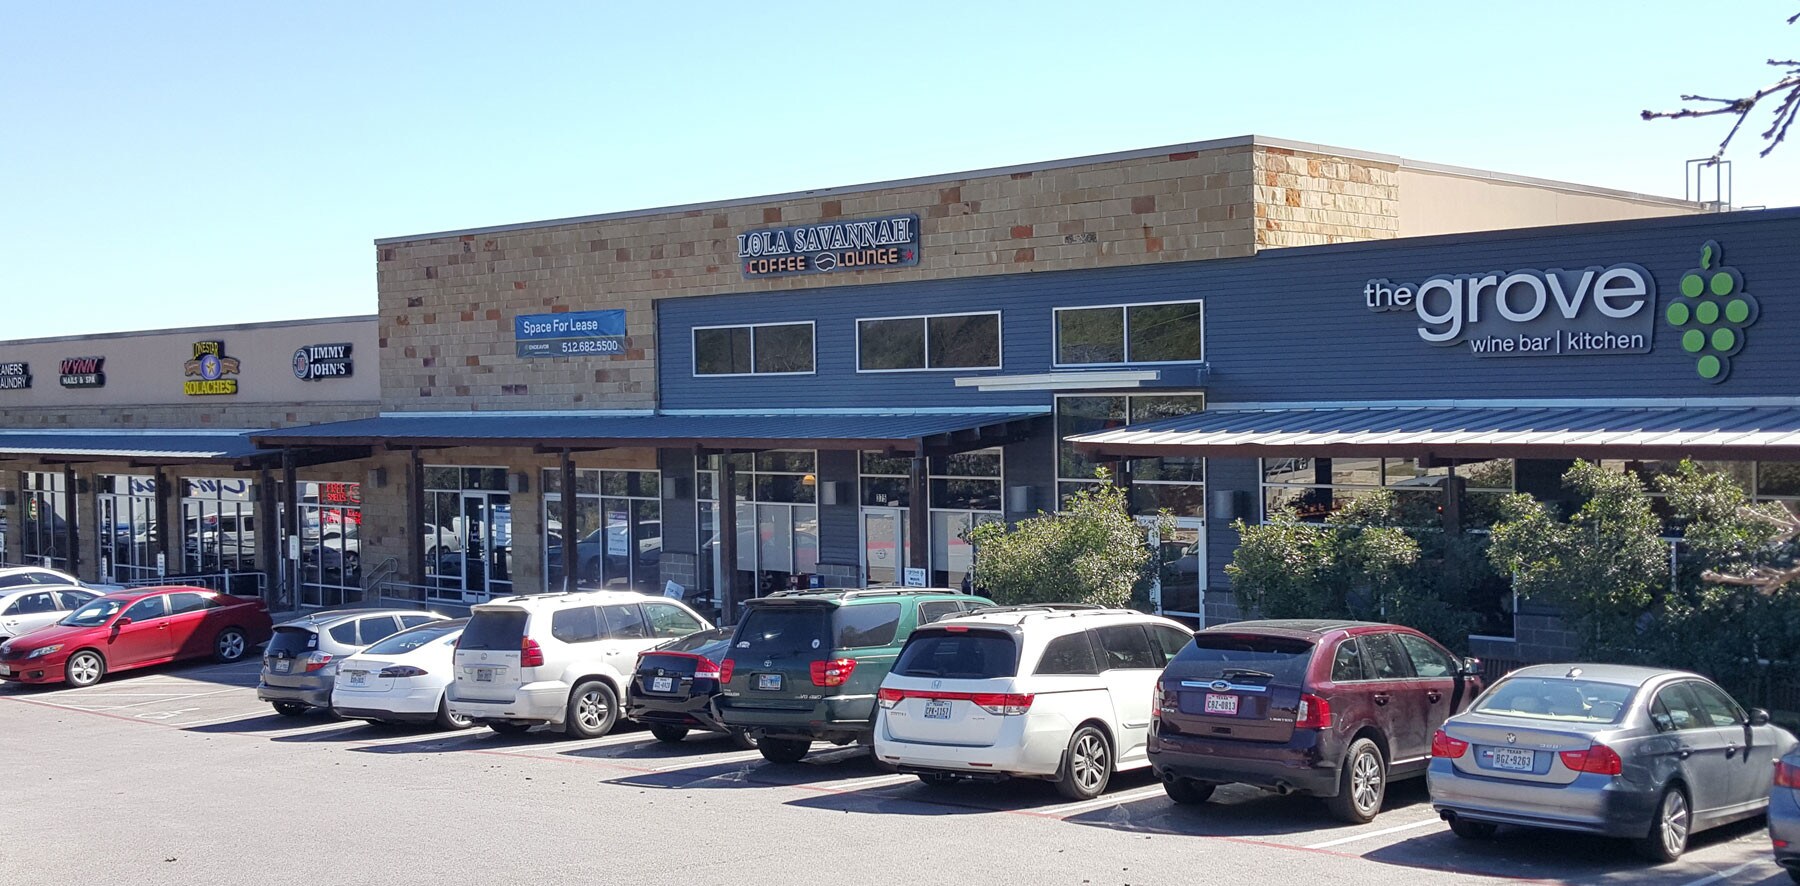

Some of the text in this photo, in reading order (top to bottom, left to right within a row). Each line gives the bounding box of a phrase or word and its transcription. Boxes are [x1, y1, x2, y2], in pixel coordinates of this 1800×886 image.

[737, 218, 911, 258] LOLA SAVANNAH
[750, 248, 898, 274] COFFEE LOUNGE
[1364, 267, 1647, 342] the grove
[523, 318, 598, 336] Space For Lease
[562, 340, 618, 353] 512.682.5500
[1471, 336, 1514, 352] wine
[1519, 334, 1551, 351] bar
[1567, 331, 1644, 350] kitchen
[310, 346, 345, 362] JIMMY
[60, 359, 98, 374] WYNN
[310, 363, 346, 379] JOHN'S
[85, 375, 96, 383] SPA
[184, 380, 232, 395] KOLACHES
